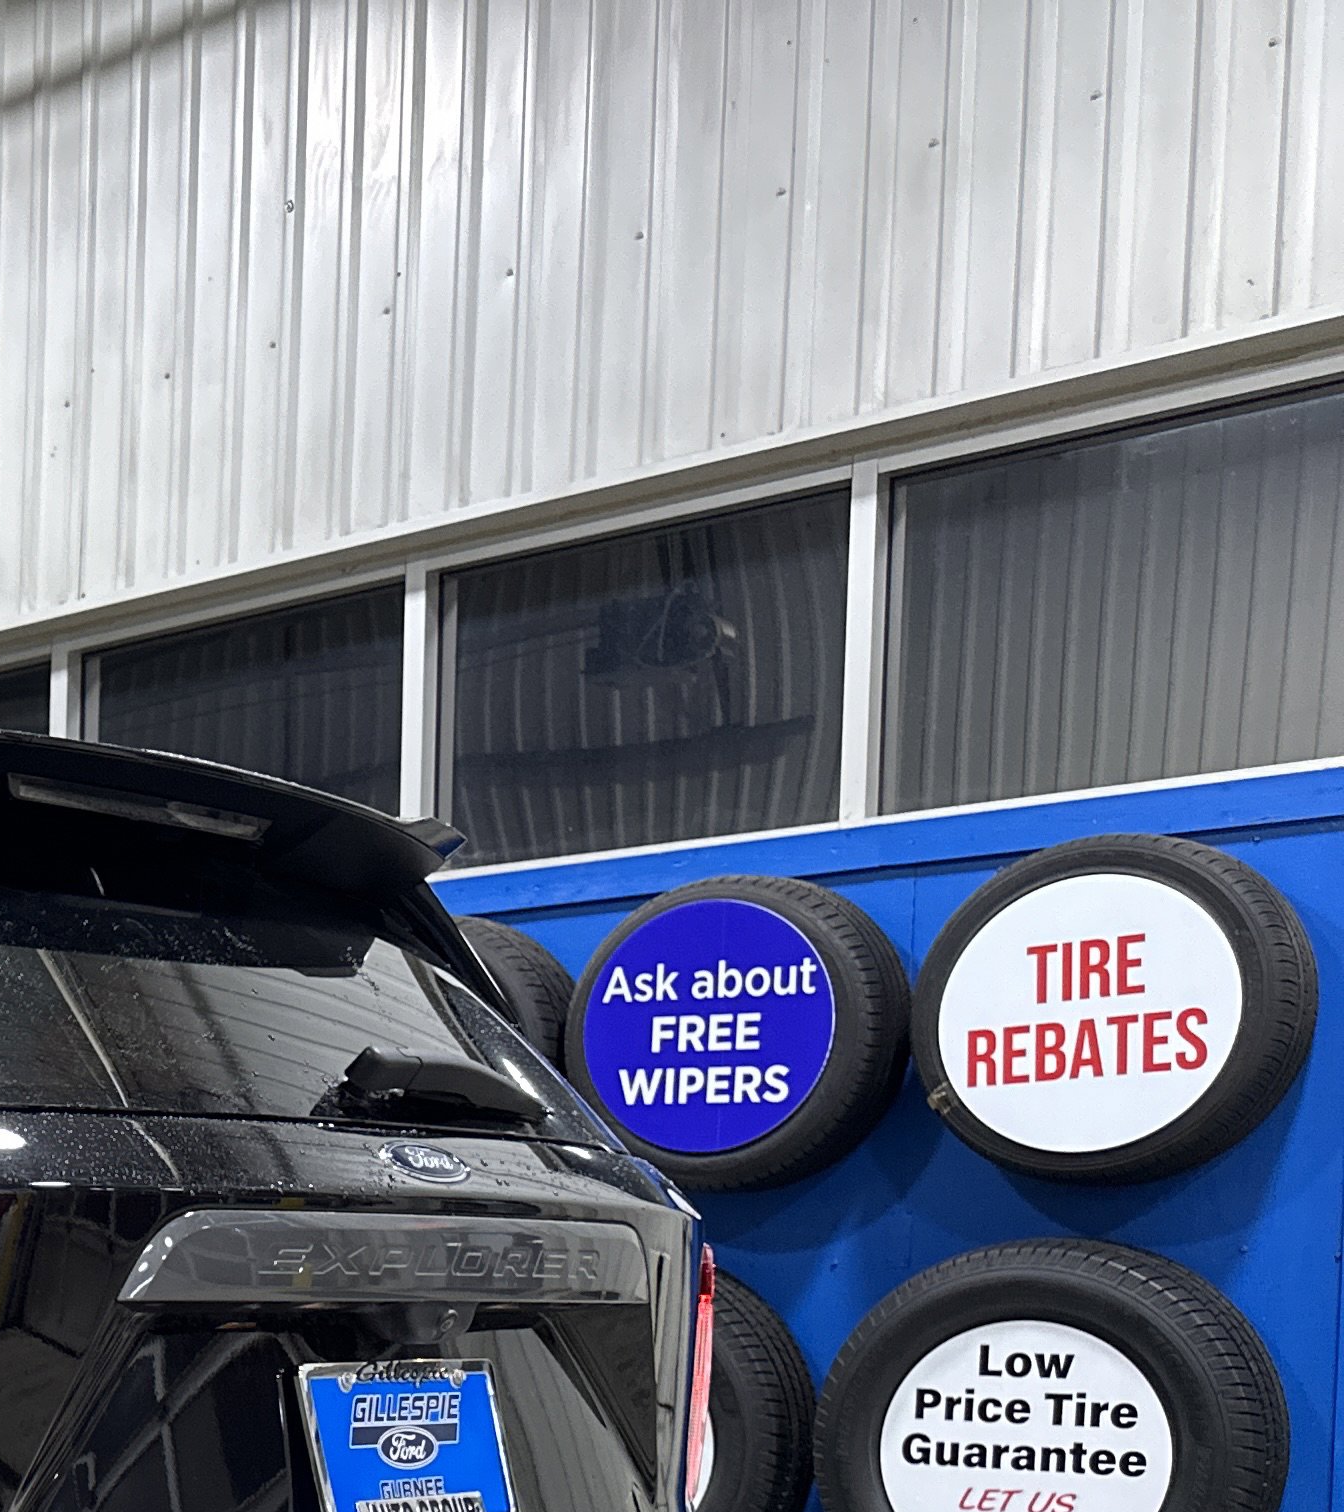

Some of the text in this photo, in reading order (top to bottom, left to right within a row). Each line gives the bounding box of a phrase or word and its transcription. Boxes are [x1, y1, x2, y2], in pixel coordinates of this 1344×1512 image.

[602, 957, 817, 1004] Ask about
[1027, 934, 1145, 1004] TIRE
[650, 1012, 762, 1053] FREE
[966, 1007, 1208, 1088] REBATES
[618, 1064, 790, 1106] WIPERS
[404, 1146, 454, 1171] Ford
[257, 1243, 602, 1281] EXPLORER
[978, 1344, 1075, 1379] Low
[352, 1392, 461, 1424] GILLESPIE
[915, 1388, 1140, 1429] Price Tire
[388, 1433, 427, 1461] Ford
[901, 1433, 1148, 1477] Guarantee
[958, 1487, 1022, 1512] LET
